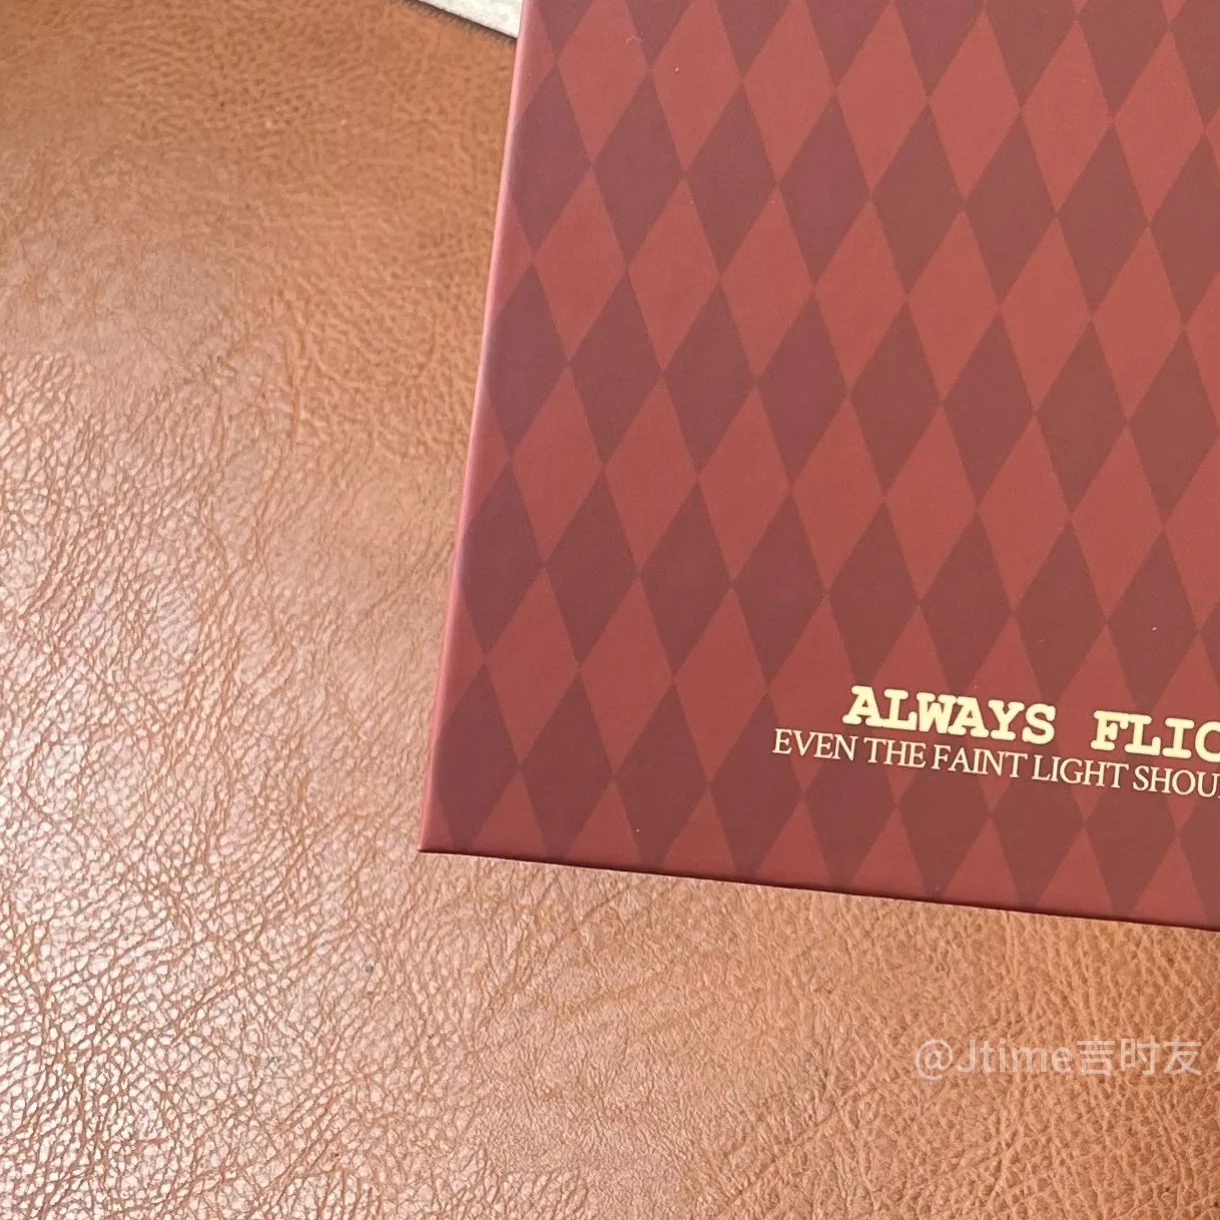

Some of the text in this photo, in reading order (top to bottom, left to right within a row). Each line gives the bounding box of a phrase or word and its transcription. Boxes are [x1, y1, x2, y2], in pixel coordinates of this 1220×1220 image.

[842, 684, 1056, 745] ALWAYS
[772, 728, 867, 761] EVEN
[863, 737, 927, 768] THE
[931, 744, 1029, 778] FAINT
[1031, 754, 1130, 791] LIGHT
